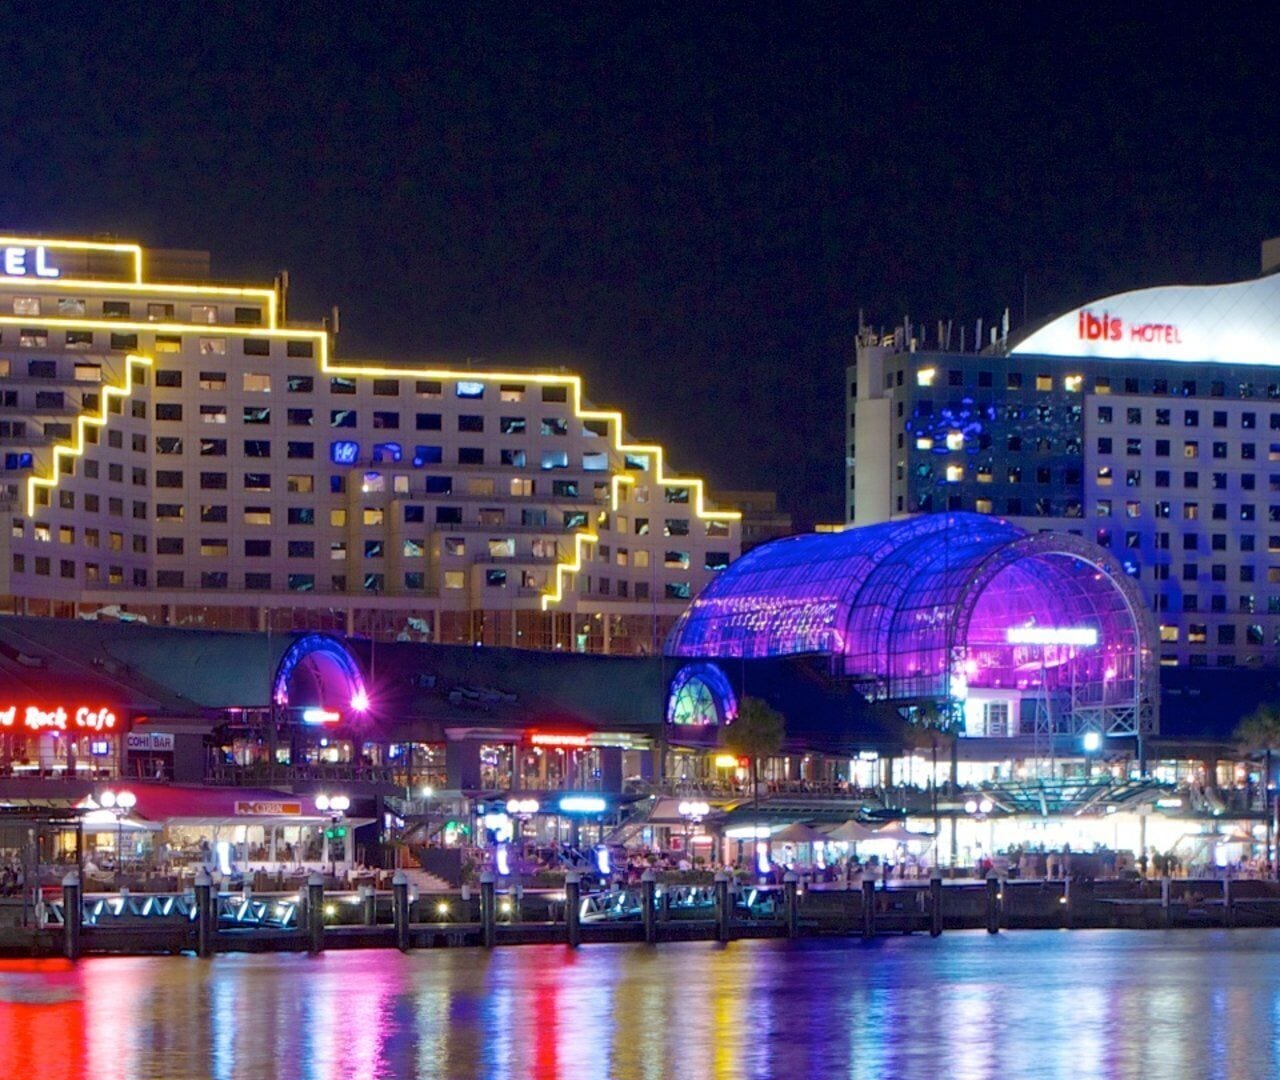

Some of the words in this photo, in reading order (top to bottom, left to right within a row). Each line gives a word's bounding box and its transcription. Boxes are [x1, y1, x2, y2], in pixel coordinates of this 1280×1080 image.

[1078, 308, 1123, 341] ibis
[1130, 323, 1183, 344] HOTEL
[25, 706, 68, 730] Rock
[76, 707, 116, 731] Cafe
